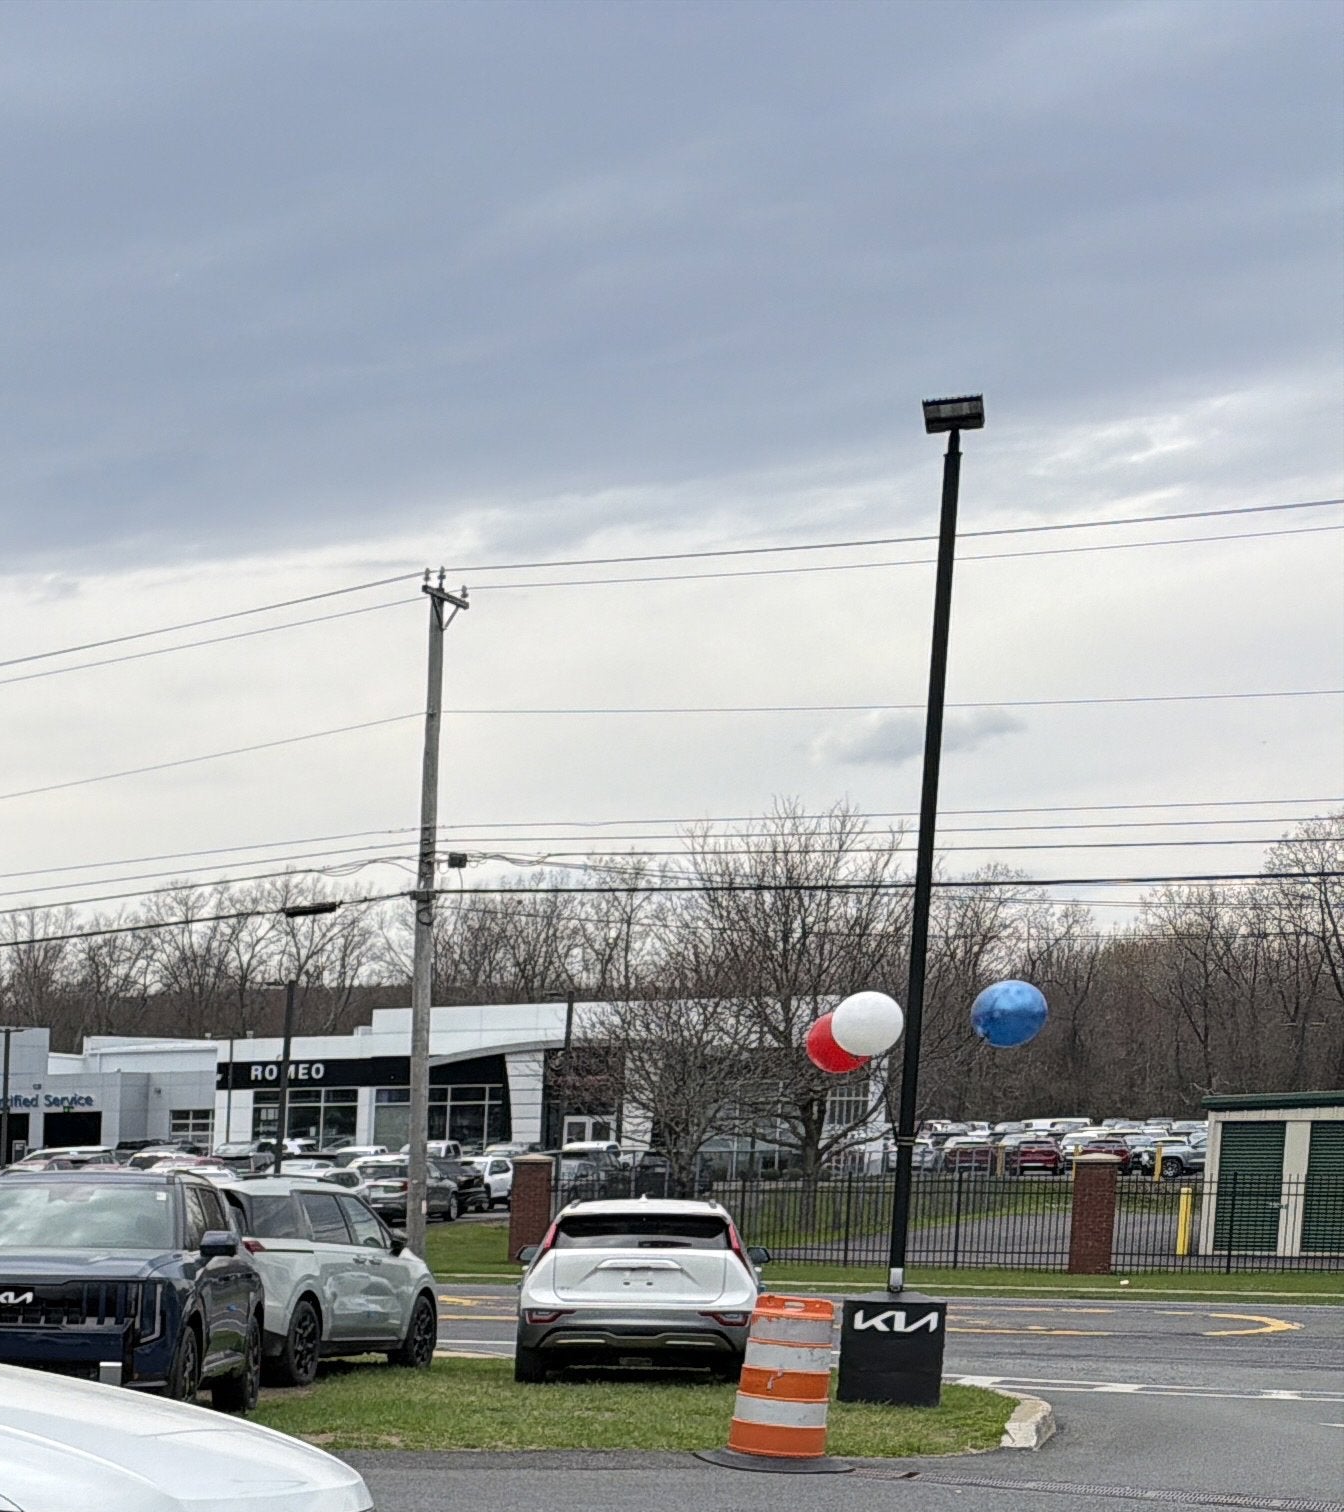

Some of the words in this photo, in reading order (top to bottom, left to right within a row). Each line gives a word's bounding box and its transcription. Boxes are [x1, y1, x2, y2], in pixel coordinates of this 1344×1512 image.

[250, 1063, 325, 1081] ROMEO
[43, 1093, 94, 1108] Service
[853, 1309, 939, 1333] KIA
